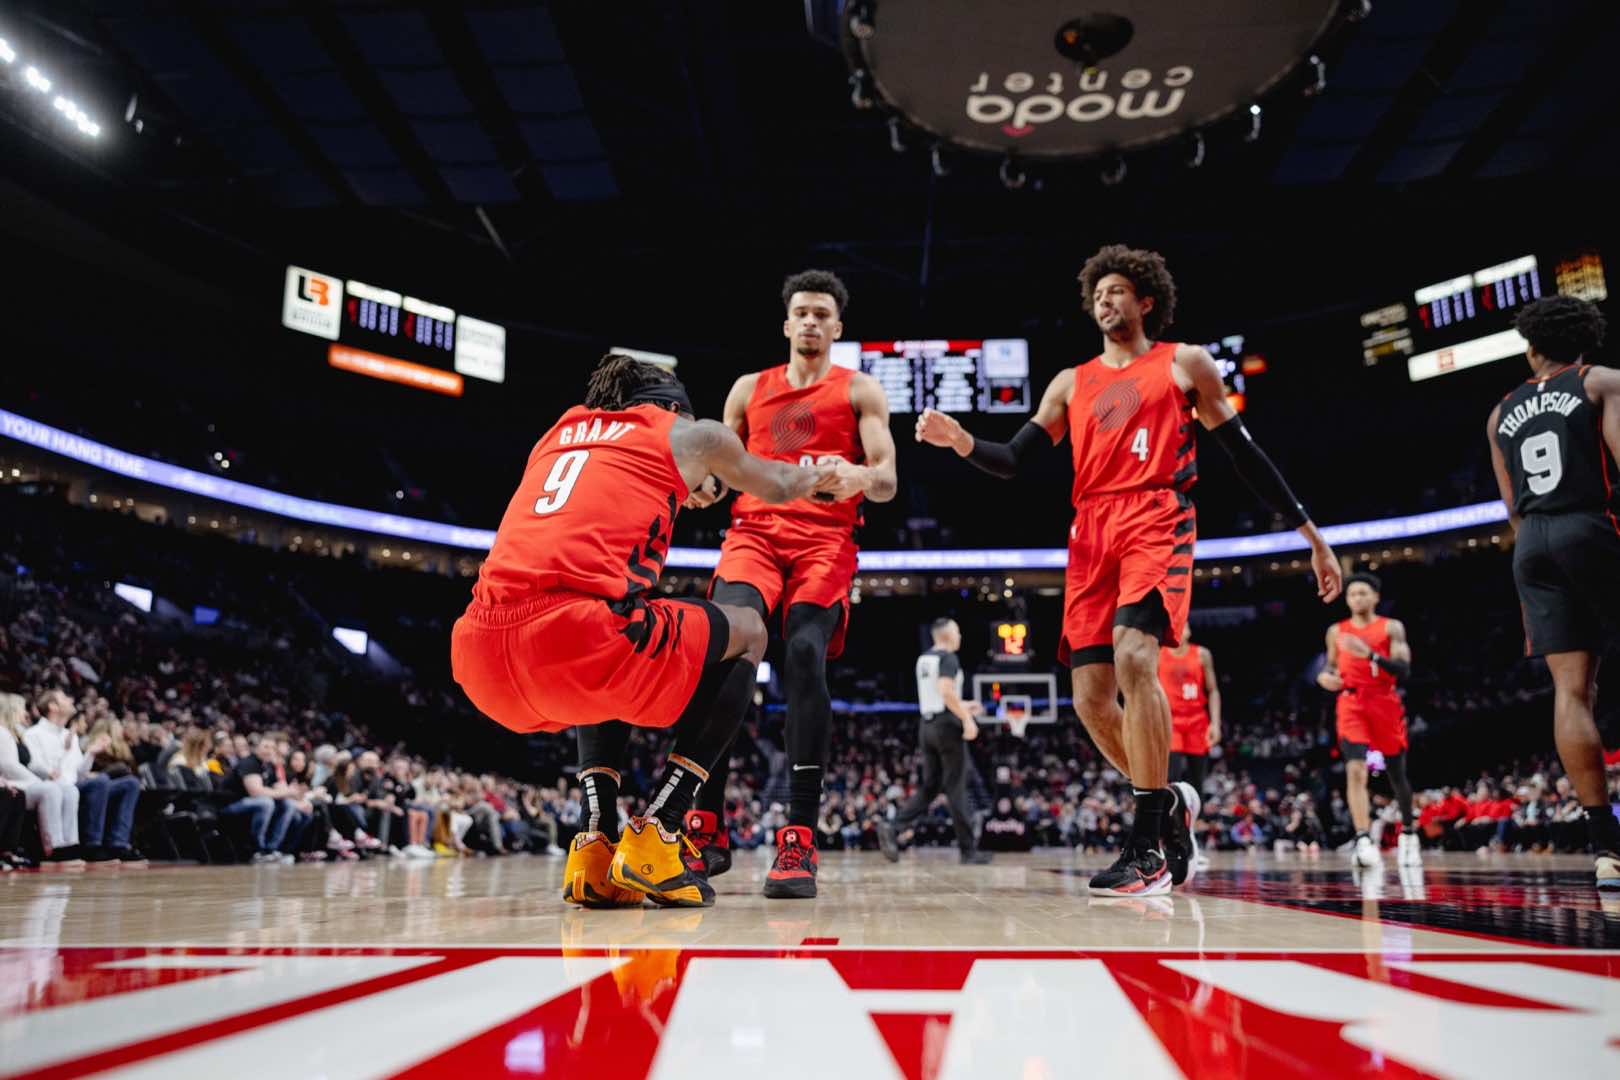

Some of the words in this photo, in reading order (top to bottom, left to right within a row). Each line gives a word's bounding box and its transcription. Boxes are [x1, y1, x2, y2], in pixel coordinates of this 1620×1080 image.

[971, 65, 1194, 93] center
[966, 88, 1186, 130] moda
[559, 417, 635, 446] GRANT
[1499, 391, 1582, 438] THOMPSON
[3, 414, 49, 444] YOUR
[54, 433, 101, 461] HANG
[1131, 427, 1149, 462] 4
[533, 449, 590, 515] 9
[1520, 430, 1563, 495] 9
